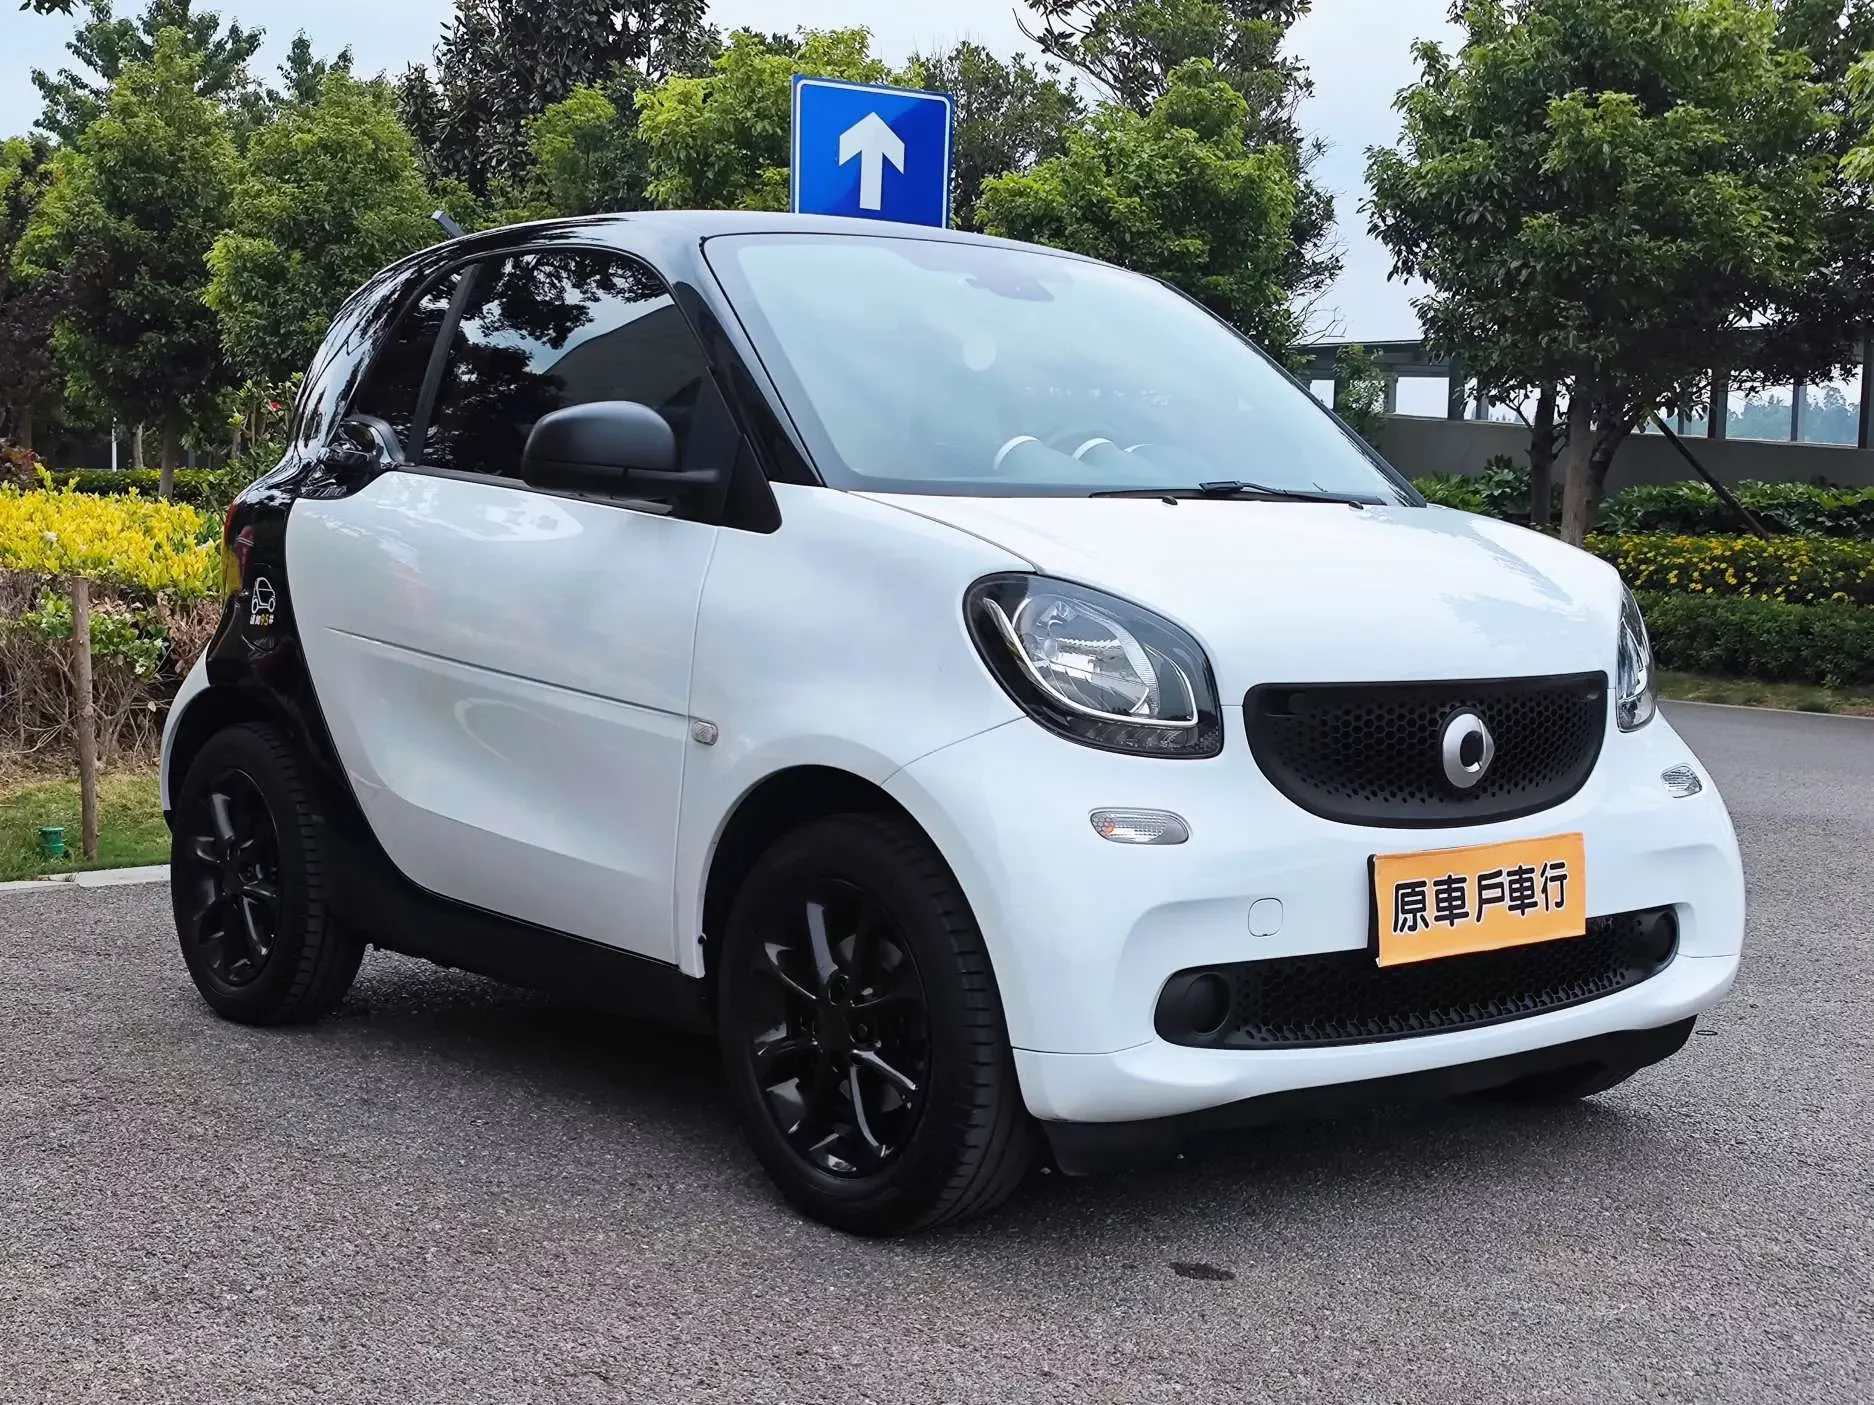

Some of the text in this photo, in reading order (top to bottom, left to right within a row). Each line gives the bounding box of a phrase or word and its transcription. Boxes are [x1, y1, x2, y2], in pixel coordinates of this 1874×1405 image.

[1392, 861, 1568, 933] 原車戶車行
